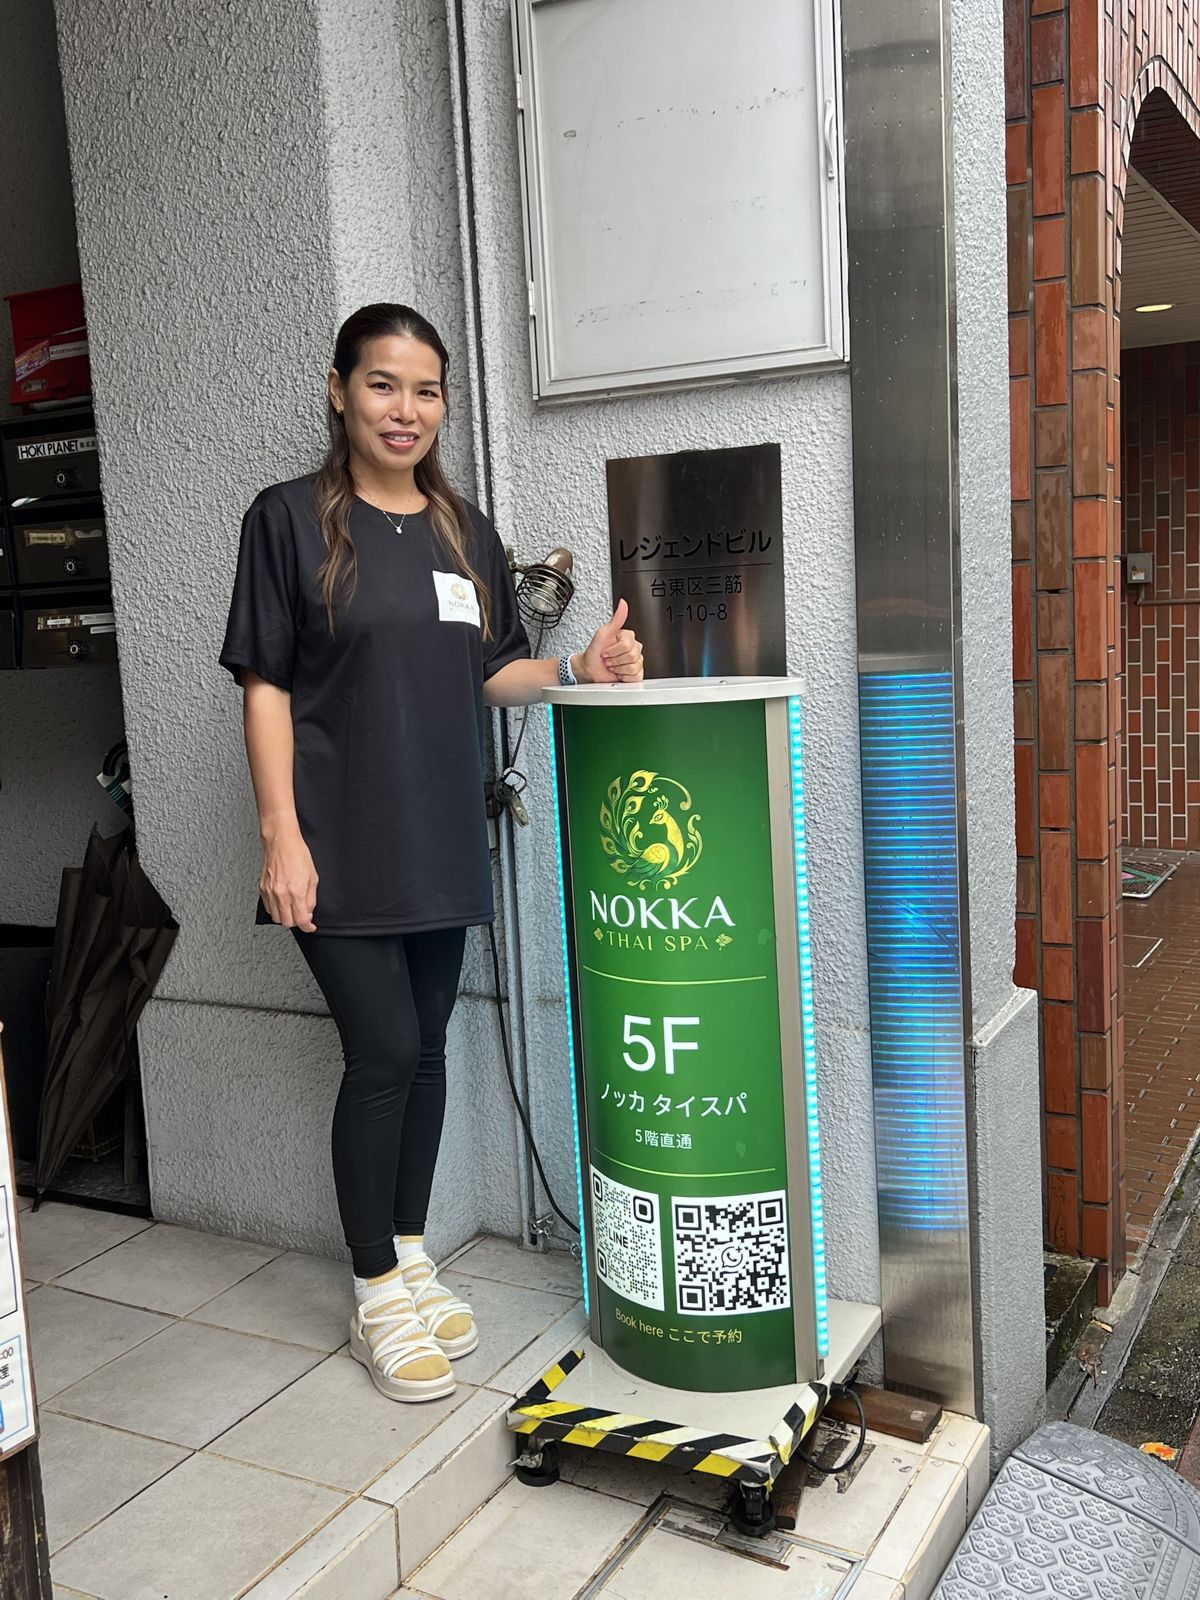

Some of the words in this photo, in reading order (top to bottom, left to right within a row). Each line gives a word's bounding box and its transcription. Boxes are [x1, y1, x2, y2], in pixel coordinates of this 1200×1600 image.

[20, 445, 46, 458] HOKI
[47, 440, 79, 455] PLANET
[619, 528, 772, 562] レジェンドビル
[650, 574, 742, 598] 台東区三筋
[665, 603, 728, 623] 1-10-8
[589, 889, 736, 930] NOKKA
[606, 930, 653, 951] THAI
[664, 935, 709, 951] SPA
[622, 1014, 700, 1075] 5F
[635, 1128, 692, 1149] 5階直通
[608, 1227, 629, 1249] LINE
[615, 1307, 637, 1329] Book
[639, 1319, 664, 1338] here
[668, 1328, 742, 1344] ここで予約
